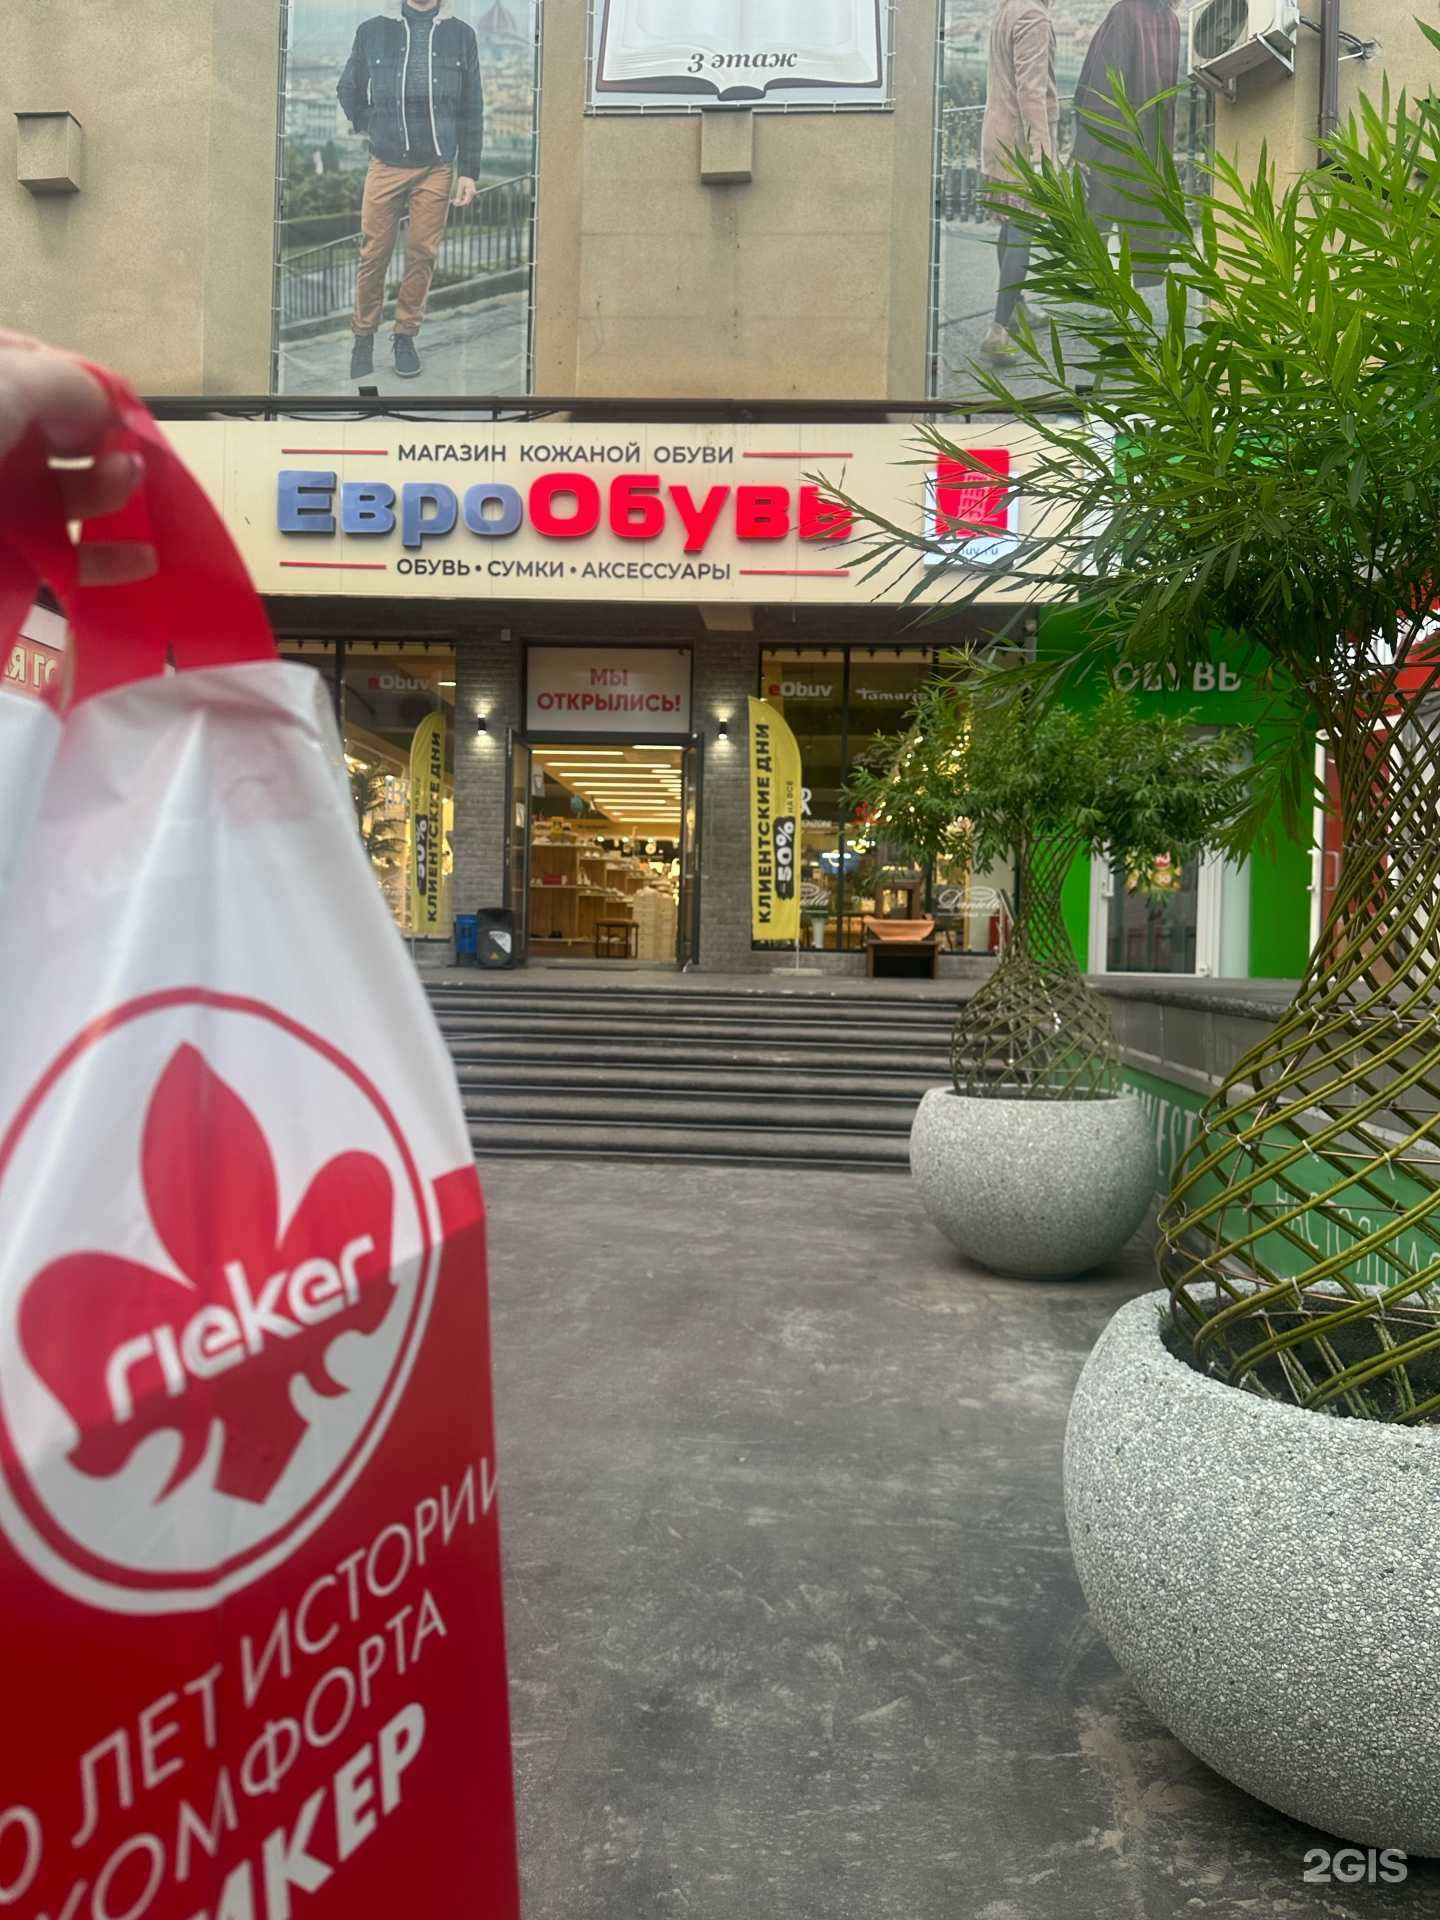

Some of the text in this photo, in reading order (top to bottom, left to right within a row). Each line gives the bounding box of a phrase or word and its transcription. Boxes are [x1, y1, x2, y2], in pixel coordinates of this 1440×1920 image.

[687, 52, 798, 73] 3 этаж
[398, 442, 734, 463] МАГАЗИН КОЖАНОЙ ОБУВИ
[396, 558, 731, 580] ОБУВЬ СУМКИ АКСЕССУАРЫ
[590, 668, 628, 686] МЫ
[536, 692, 681, 712] ОТКРЫЛИСЬ!
[430, 731, 441, 775] ДНИ
[757, 723, 772, 923] КЛИЕНТСКИЕ ДНИ
[105, 1234, 375, 1423] rieker
[36, 1589, 447, 1920] ОМФОРТА
[70, 1661, 224, 1849] ЛЕТ
